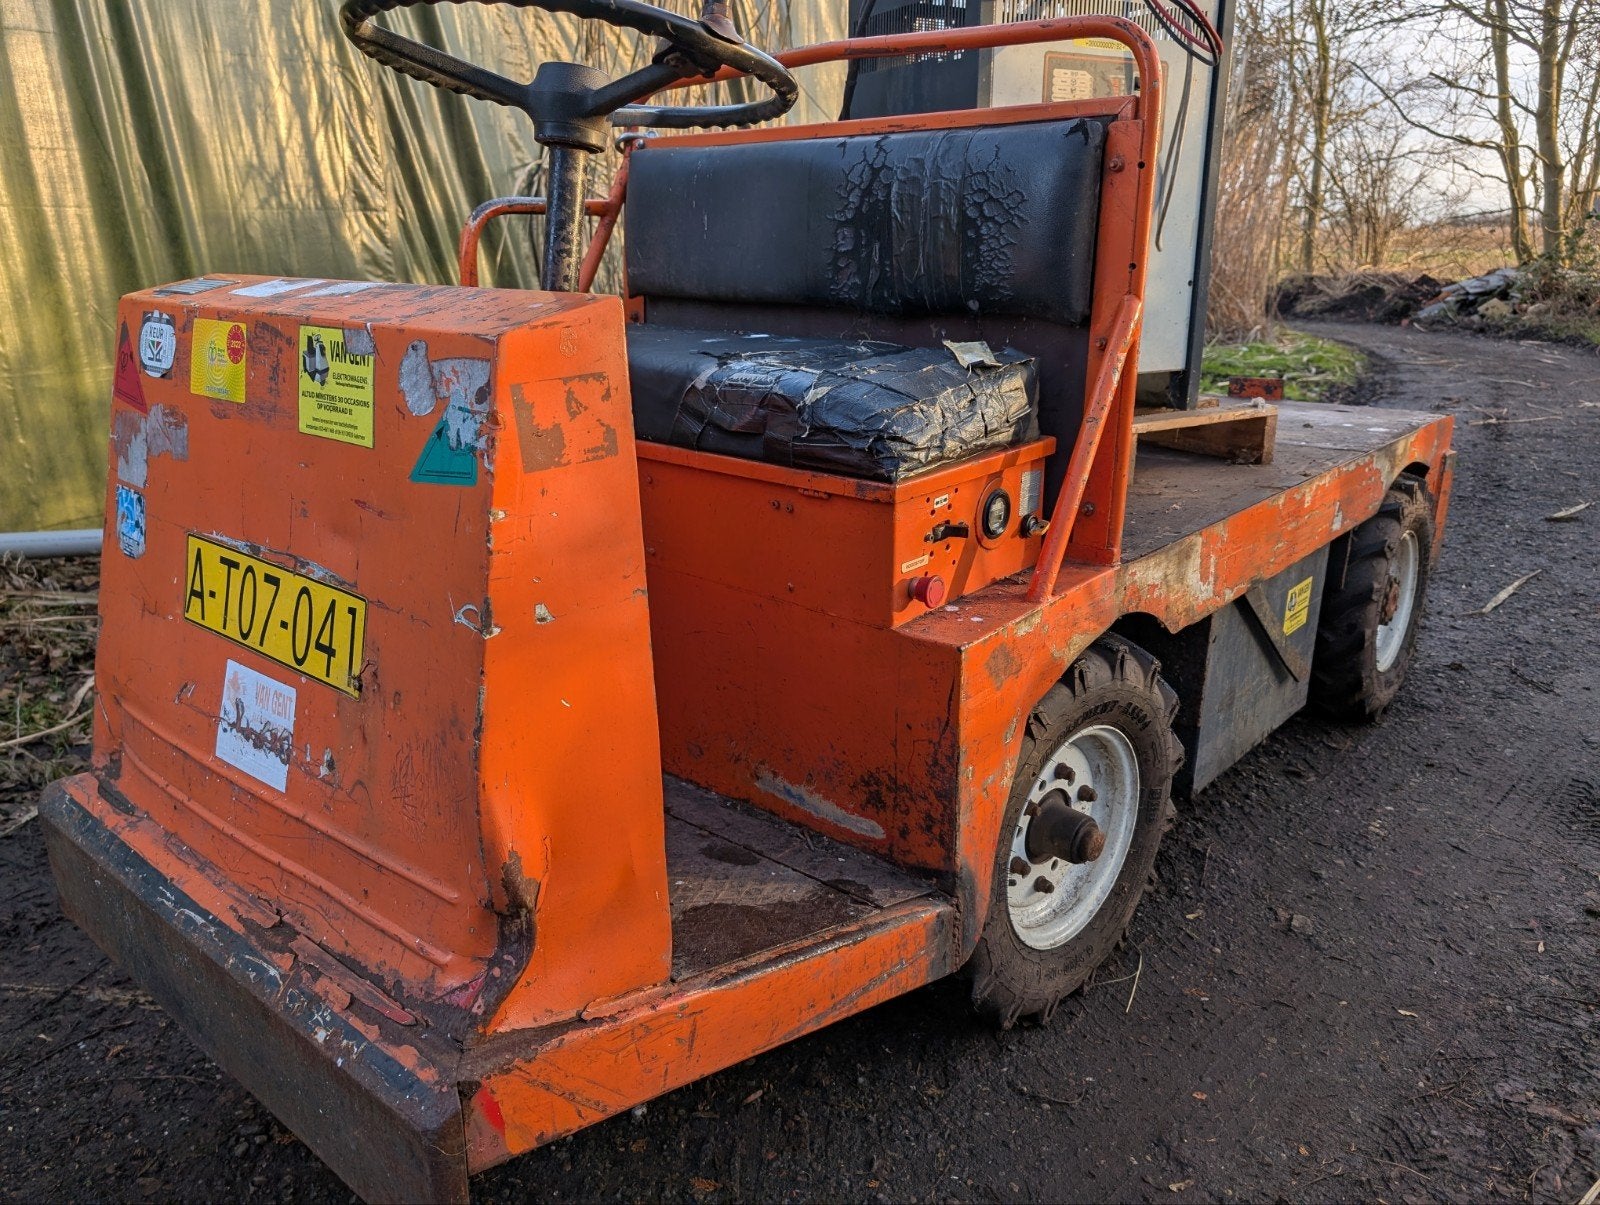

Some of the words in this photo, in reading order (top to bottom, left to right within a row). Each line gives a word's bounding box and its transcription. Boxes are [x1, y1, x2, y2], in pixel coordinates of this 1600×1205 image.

[230, 340, 242, 349] 2022
[330, 340, 347, 364] VAN
[185, 547, 357, 689] A-T07-041
[256, 681, 271, 711] VAN
[271, 689, 293, 721] GENT
